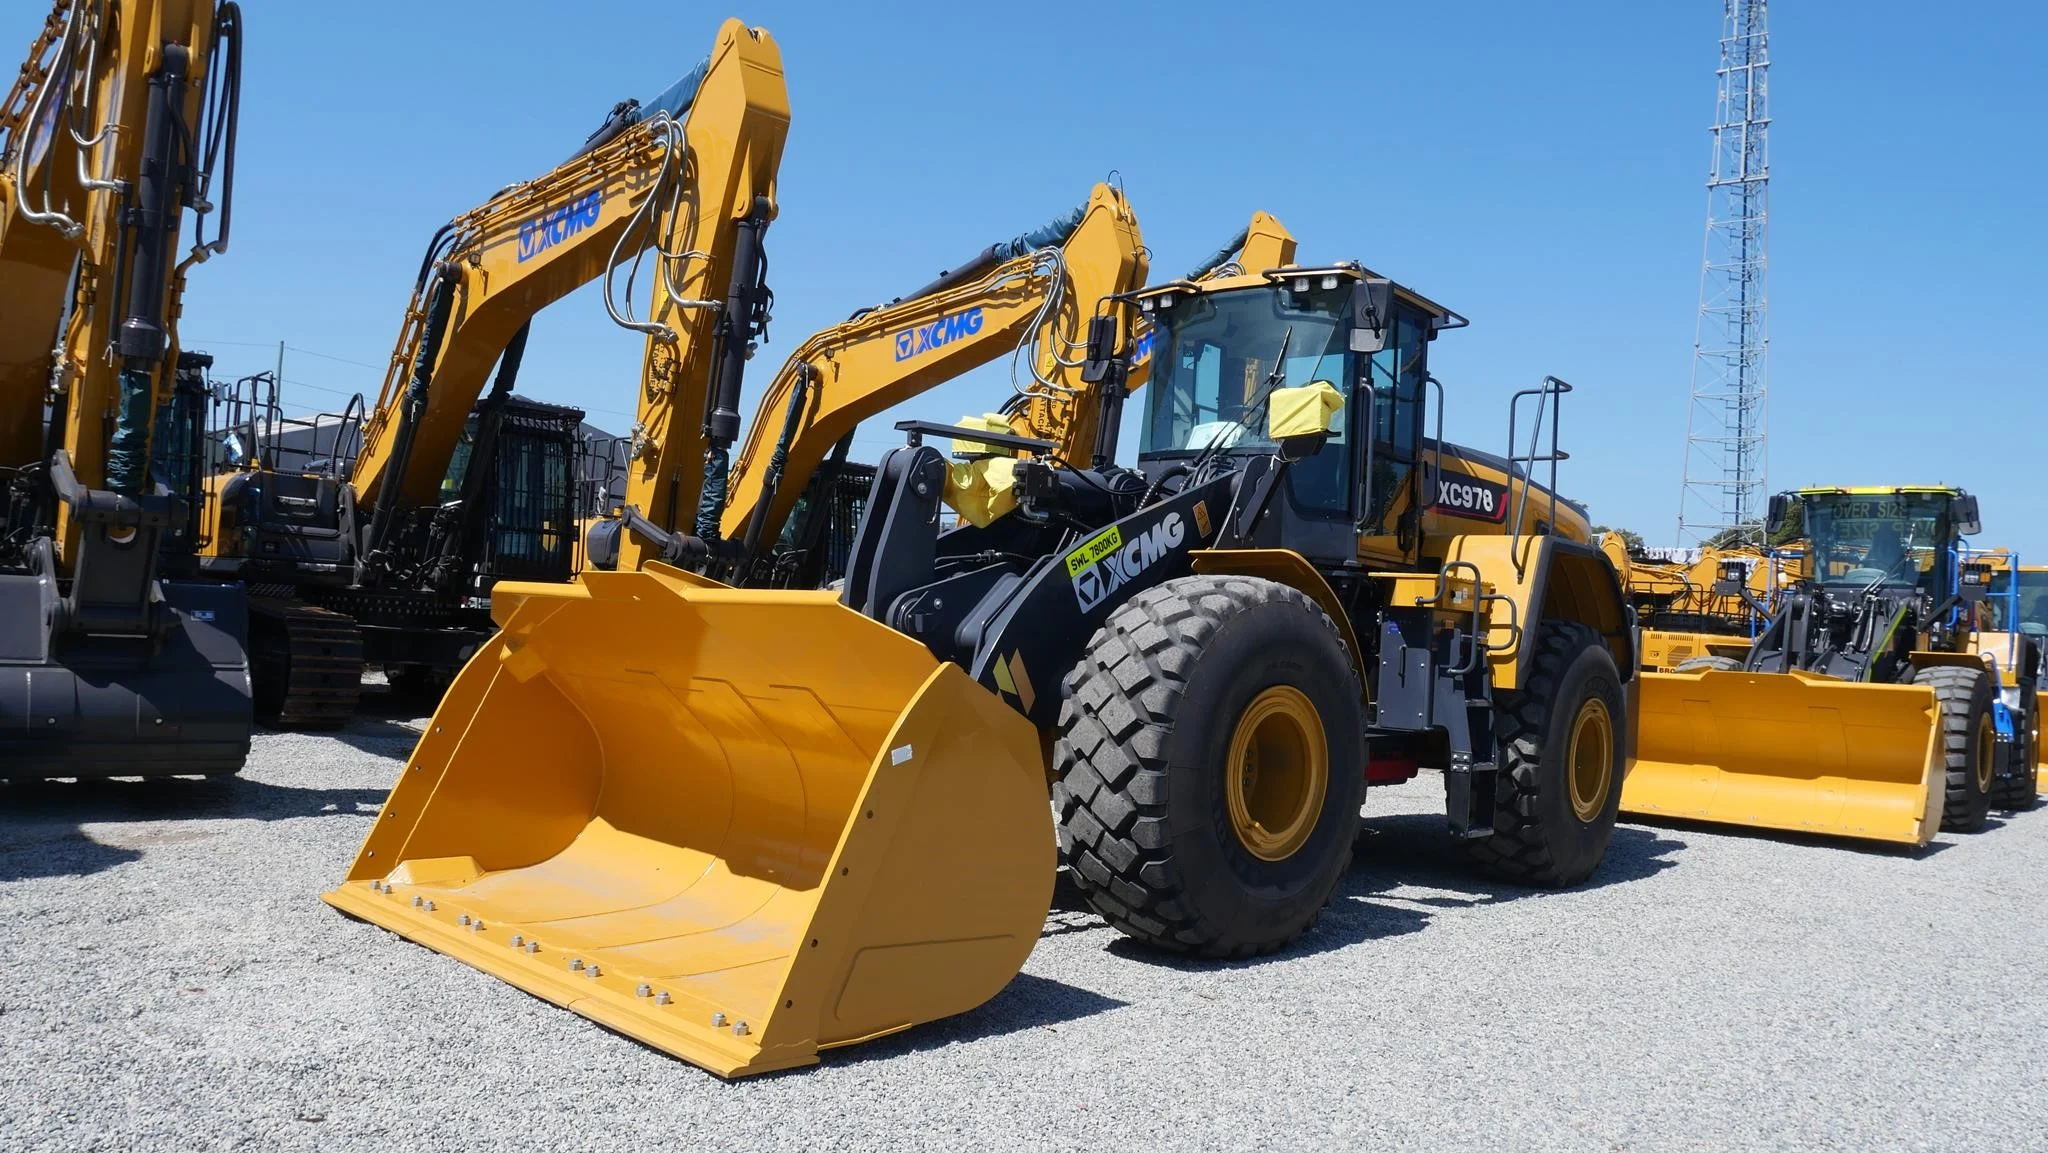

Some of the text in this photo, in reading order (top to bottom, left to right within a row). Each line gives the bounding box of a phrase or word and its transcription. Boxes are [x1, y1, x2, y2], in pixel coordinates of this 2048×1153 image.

[534, 190, 601, 255] XCMG
[913, 306, 984, 356] XCMG
[1438, 480, 1494, 512] XC978
[1833, 501, 1908, 518] OVER SIZE
[1070, 532, 1118, 571] SWL 7800KG
[1102, 511, 1185, 597] XCMG
